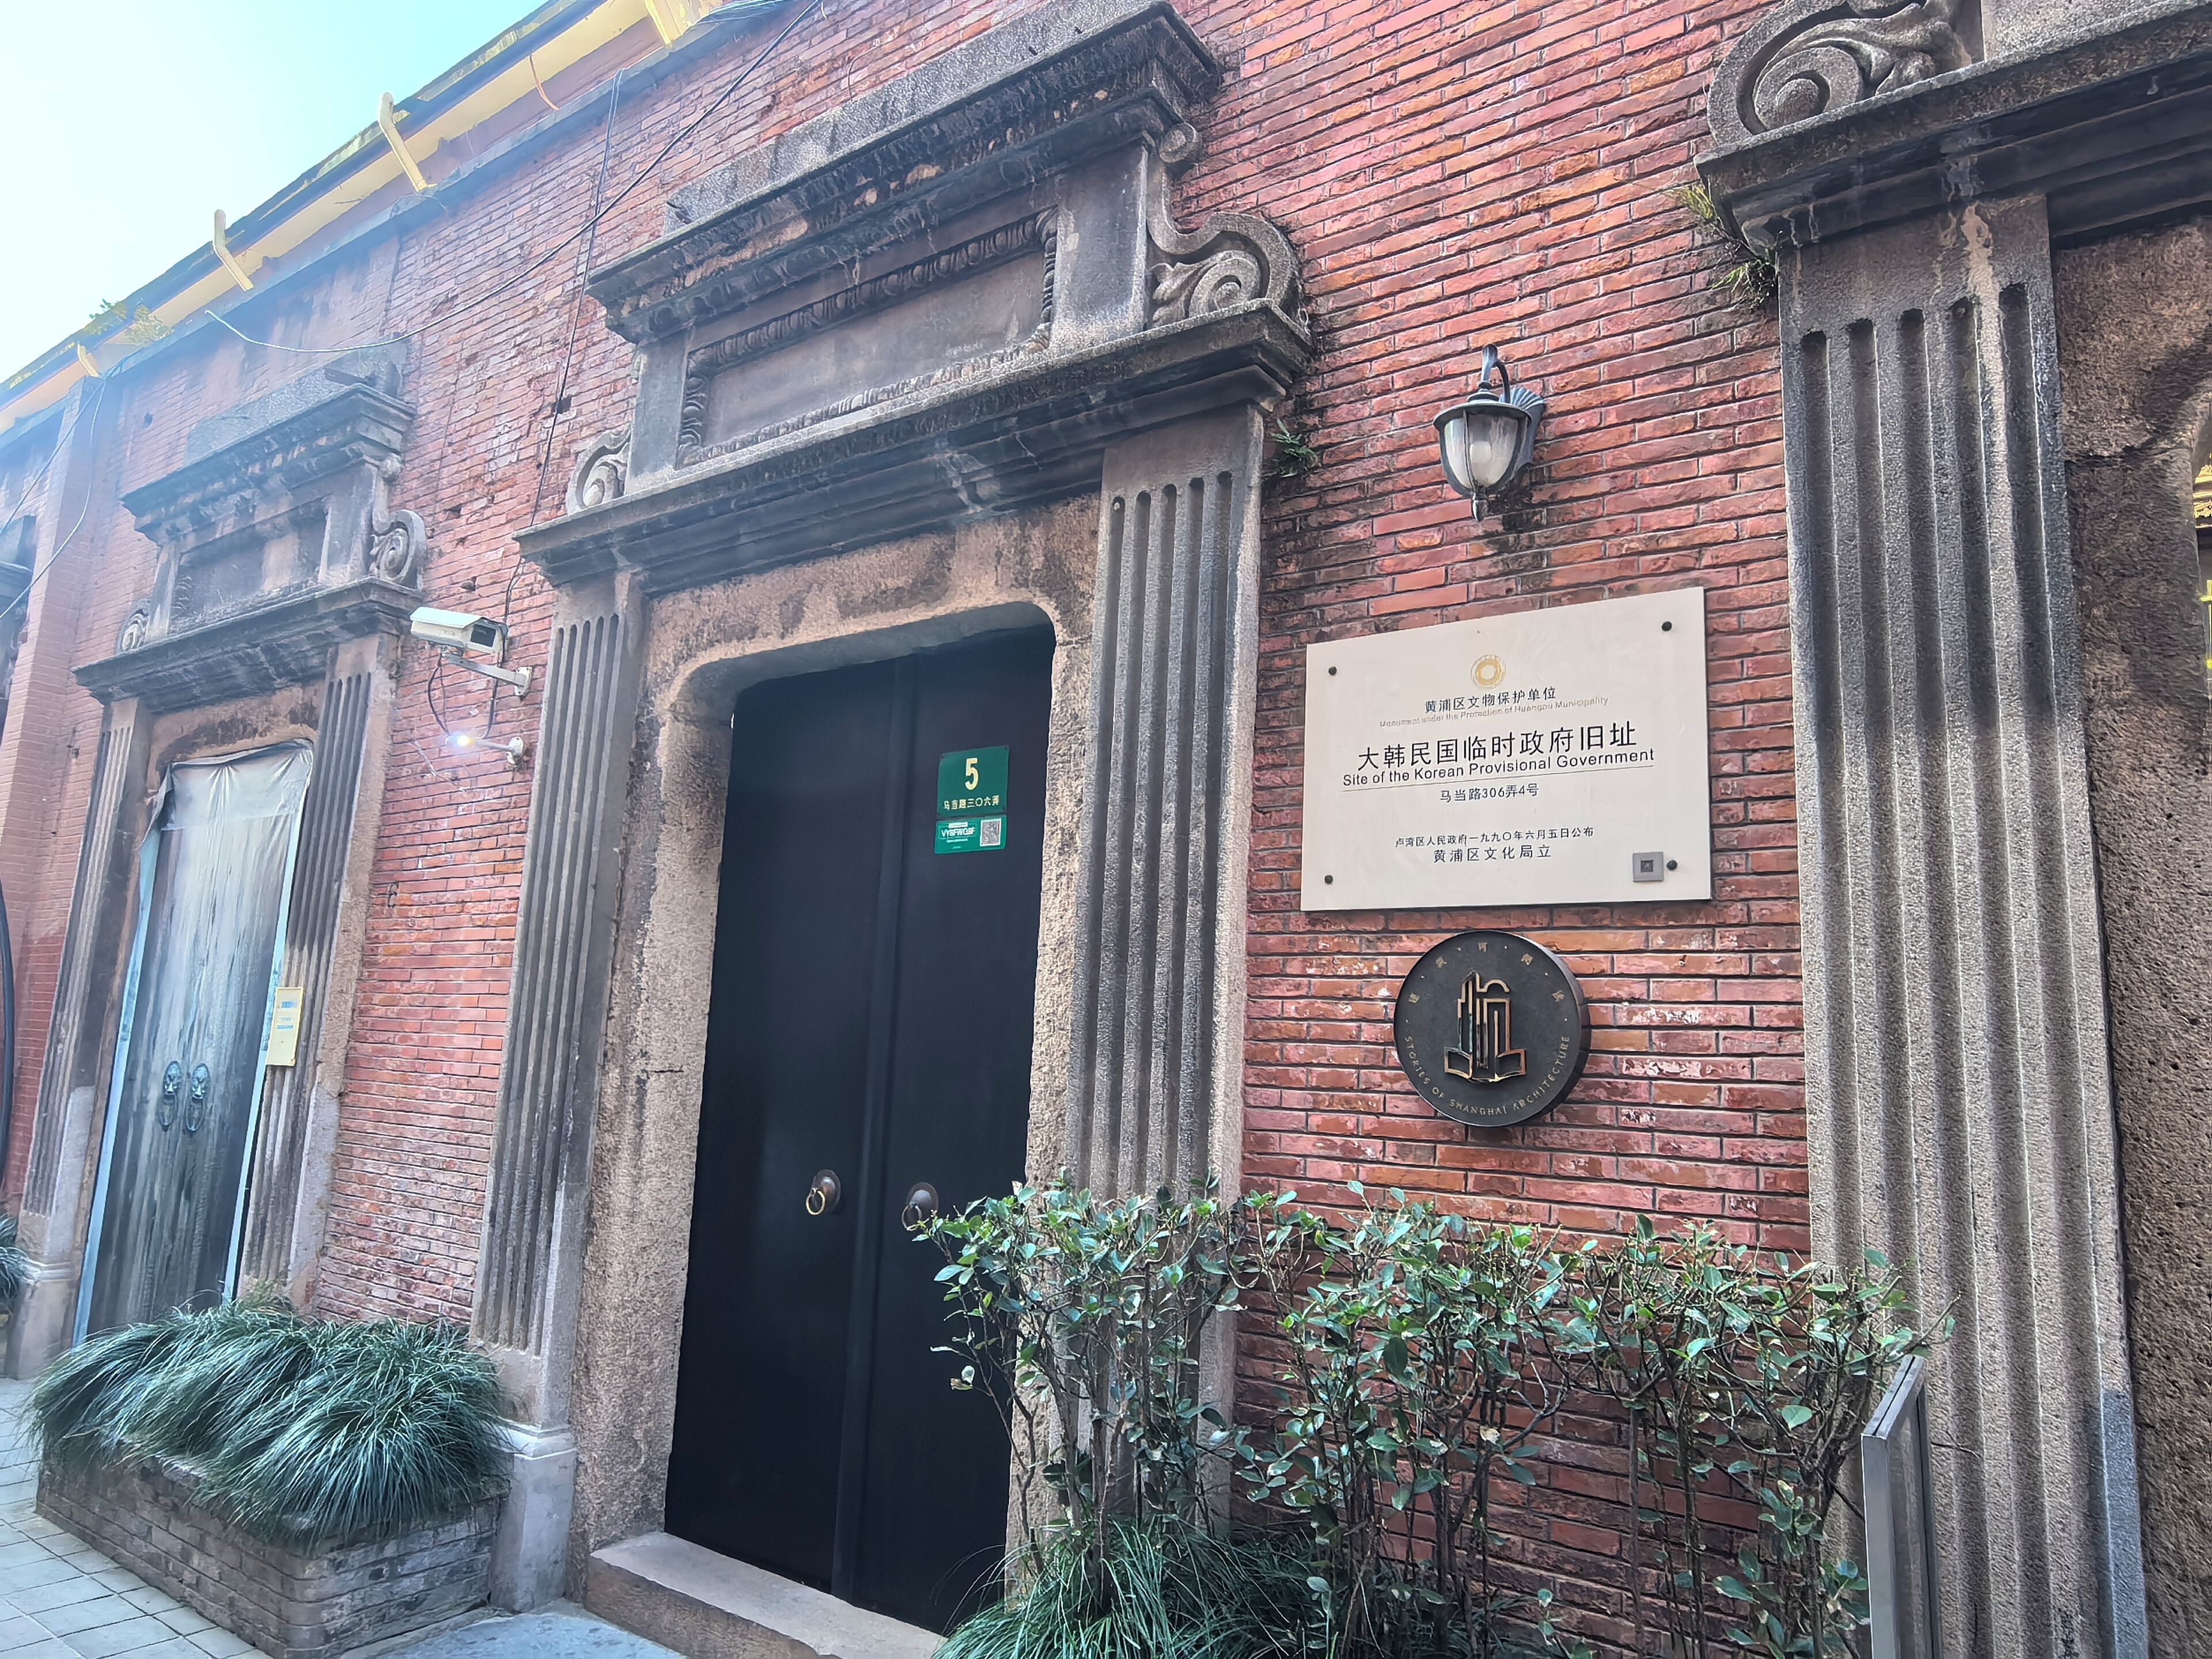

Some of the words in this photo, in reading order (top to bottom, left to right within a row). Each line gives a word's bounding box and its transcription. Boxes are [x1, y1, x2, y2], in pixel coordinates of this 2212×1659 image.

[1425, 686, 1556, 714] 黄浦区文物保护单位
[1358, 721, 1637, 771] 大韩民国临时政府旧址
[965, 757, 979, 790] 5
[1343, 774, 1368, 786] Site
[1373, 771, 1385, 784] of
[1389, 770, 1409, 782] the
[1415, 766, 1464, 781] Korean
[1469, 756, 1551, 775] Provisional
[1557, 748, 1654, 768] Government
[1440, 783, 1539, 803] 马当路306弄4号
[1433, 844, 1551, 863] 黄浦区文化局立
[1405, 1036, 1430, 1084] STORIES
[1433, 1087, 1445, 1099] OF
[1449, 1099, 1507, 1115] SHANGHAI
[1513, 1036, 1570, 1111] ARCHITECTURE
